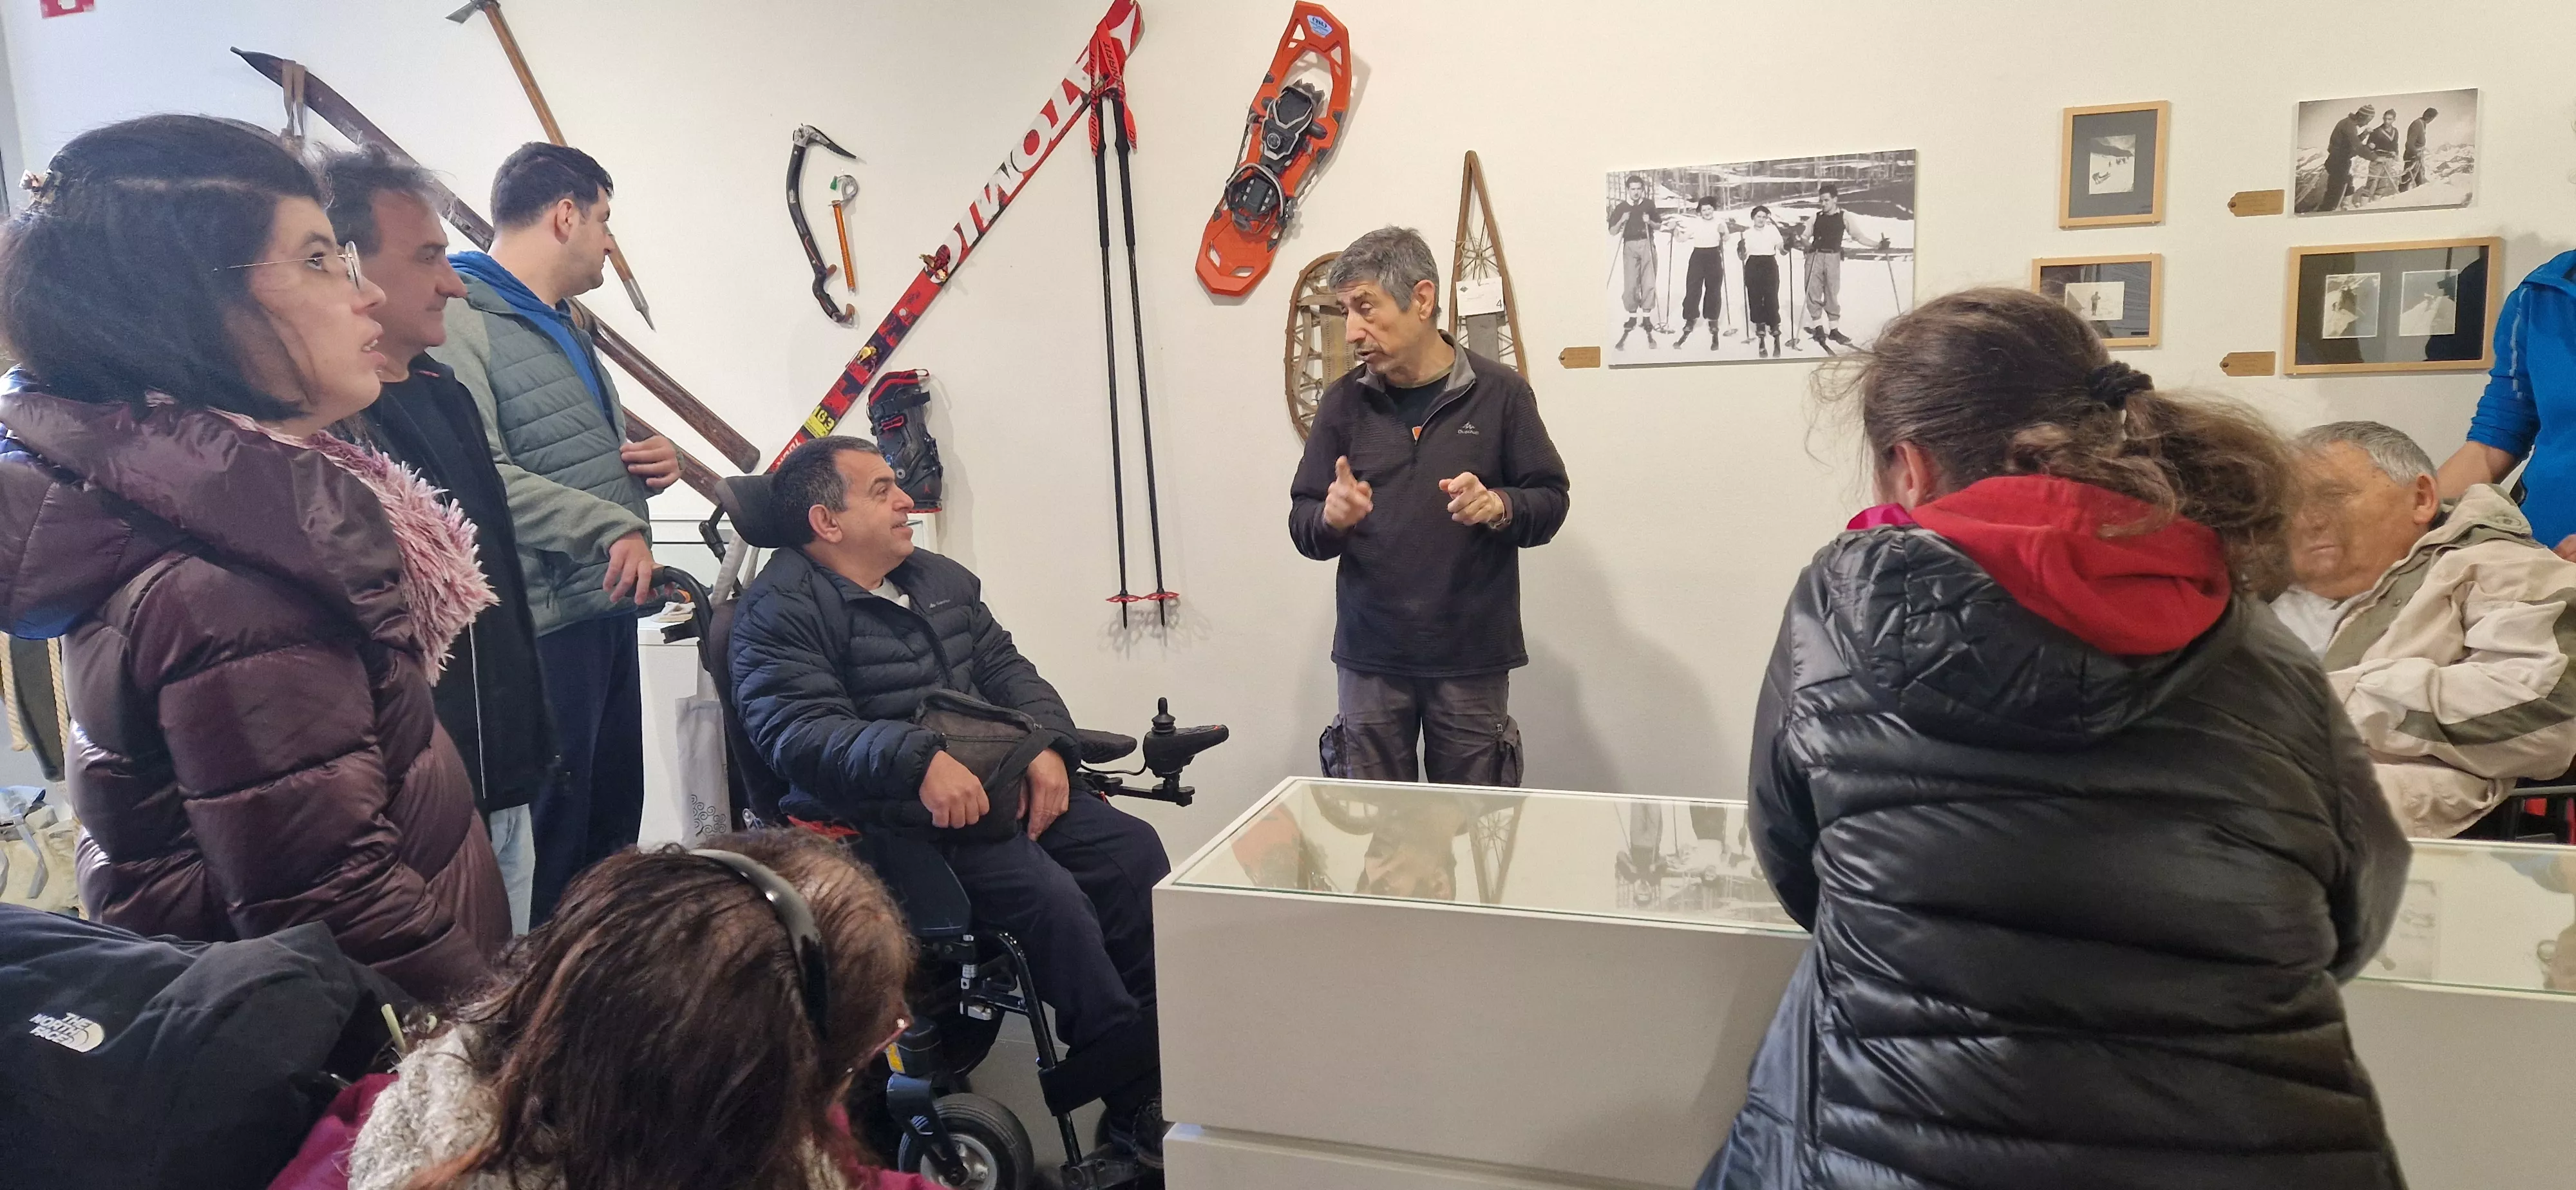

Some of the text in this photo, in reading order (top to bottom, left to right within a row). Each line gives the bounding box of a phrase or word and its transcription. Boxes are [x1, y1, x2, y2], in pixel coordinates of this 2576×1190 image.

[1103, 41, 1122, 81] NAFIT
[925, 44, 1093, 283] ATOMIC
[1496, 299, 1502, 308] 4
[28, 1013, 82, 1036] NORTH
[62, 1012, 93, 1029] THE
[29, 1026, 70, 1043] FACE
